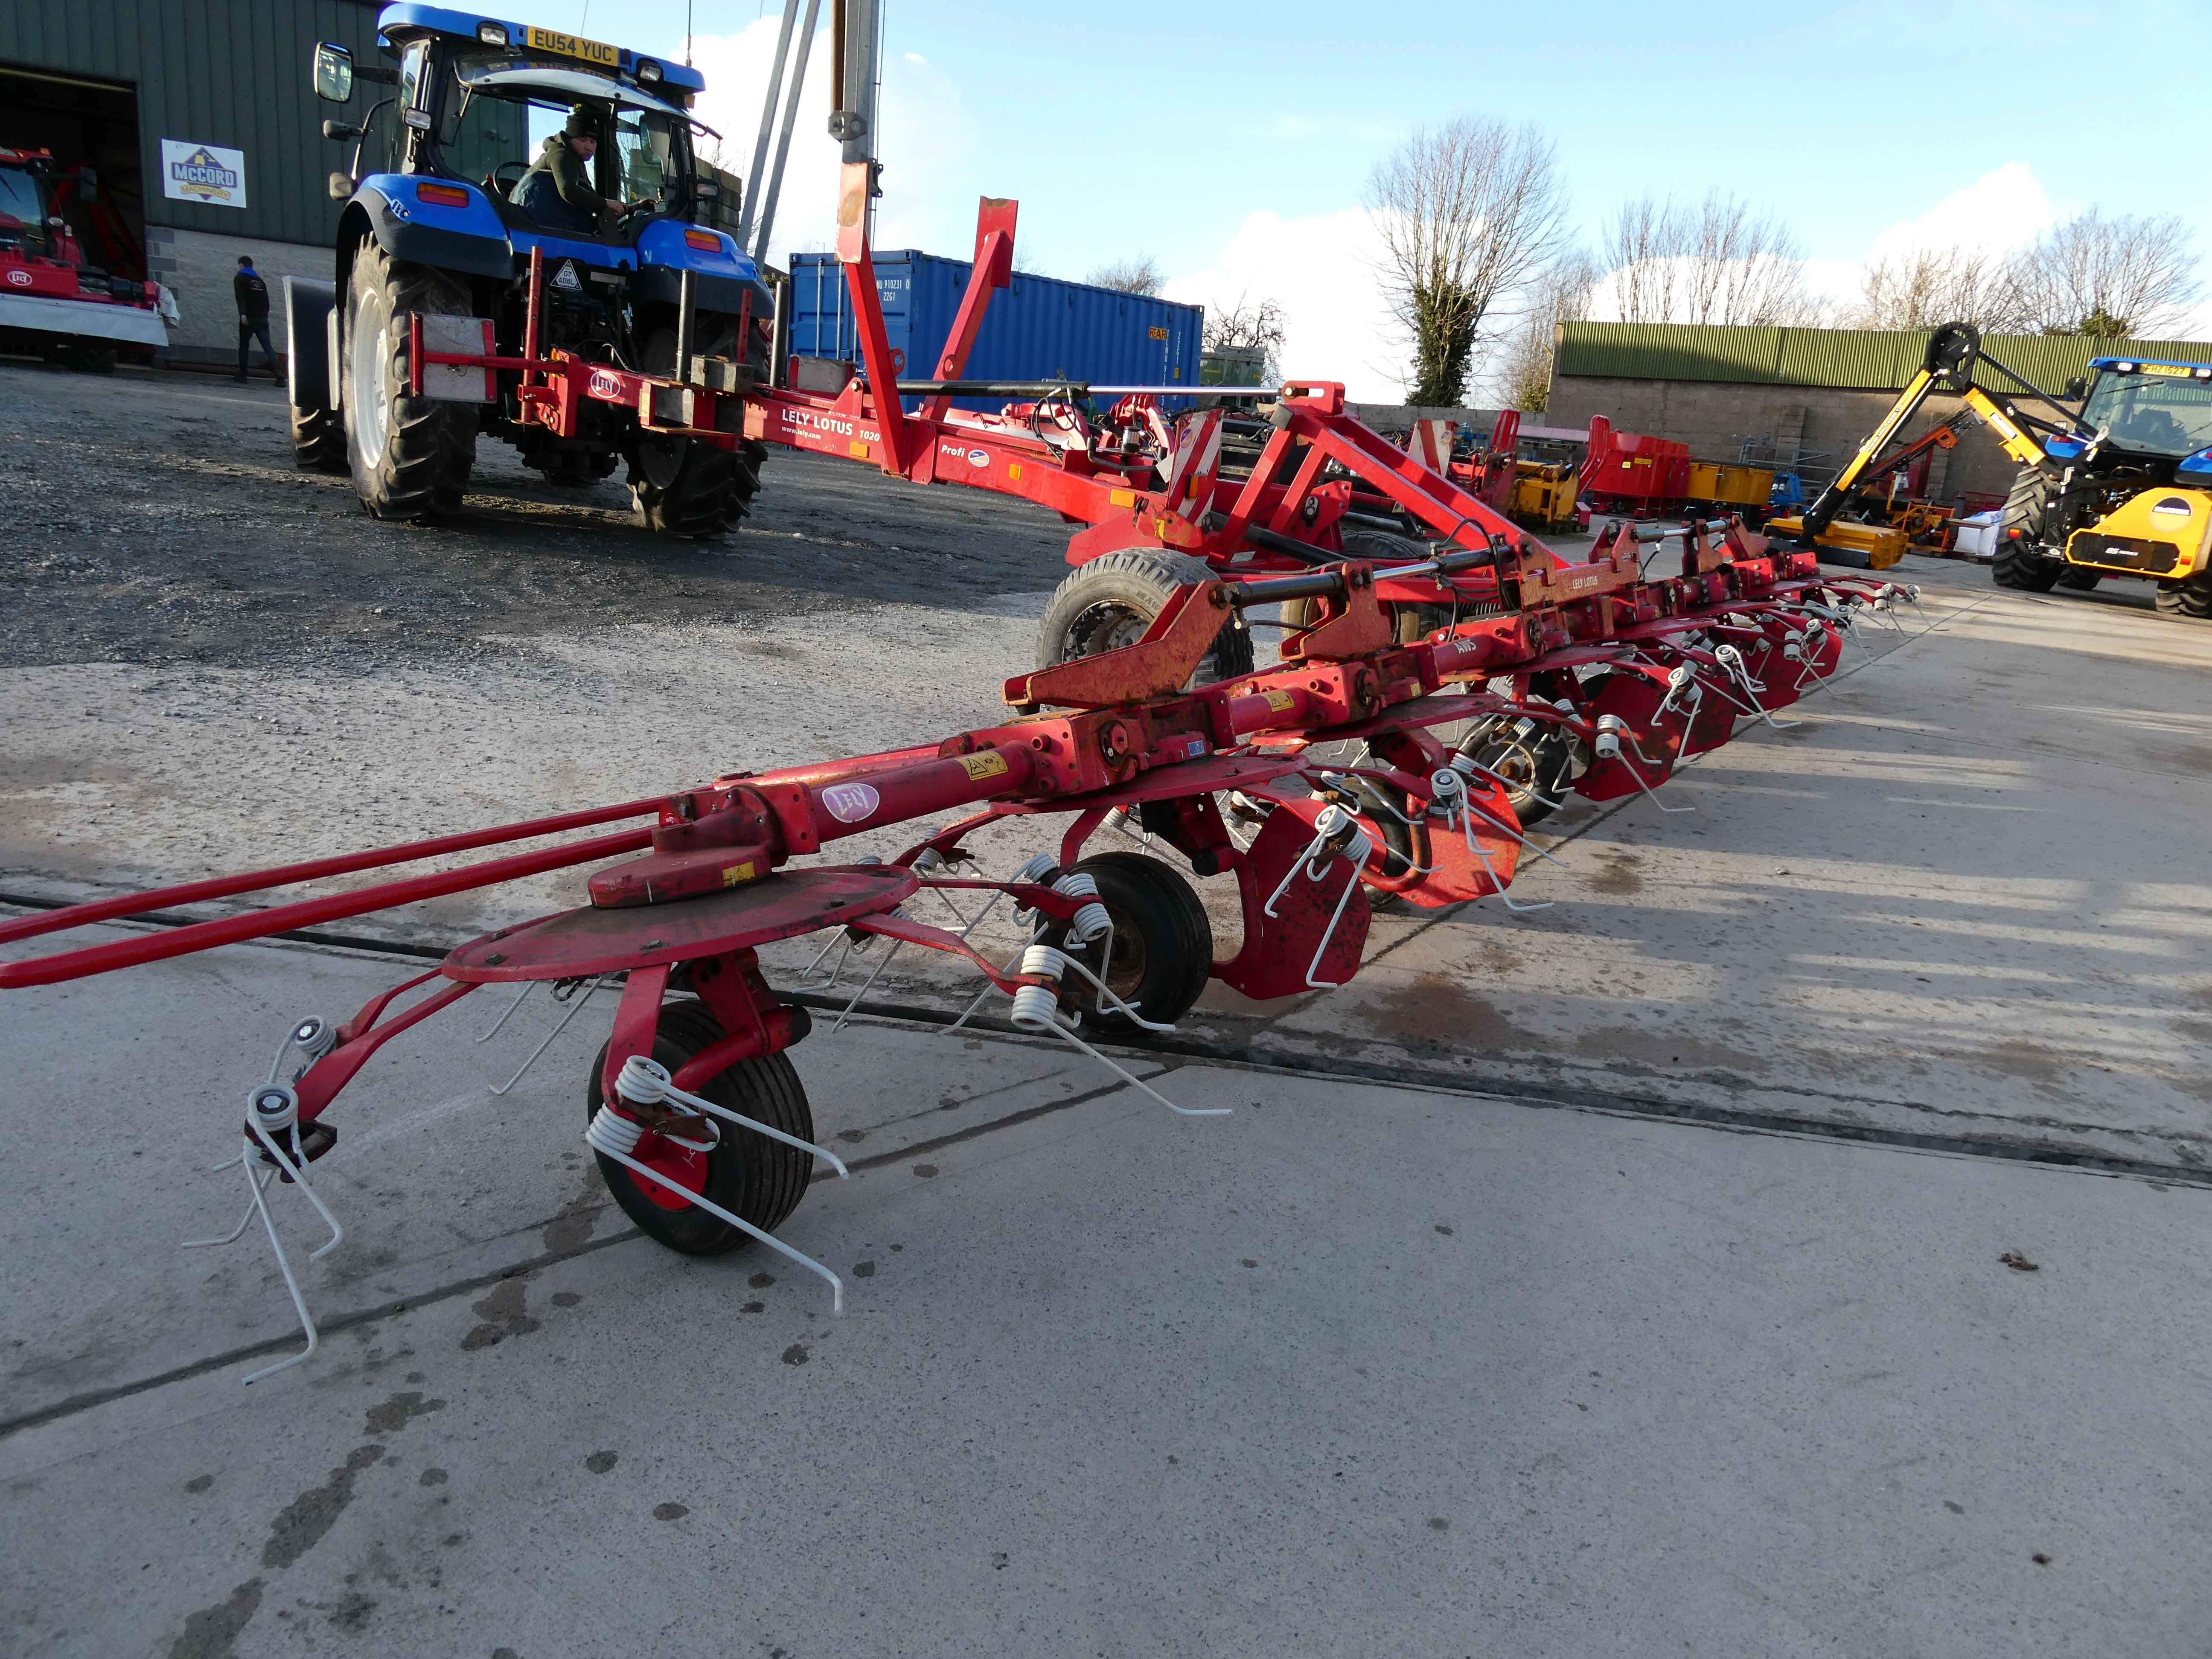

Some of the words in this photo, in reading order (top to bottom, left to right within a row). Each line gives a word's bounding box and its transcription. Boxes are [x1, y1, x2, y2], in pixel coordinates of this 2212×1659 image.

[535, 29, 576, 53] EU54
[582, 41, 611, 61] YUC
[181, 186, 228, 198] MACHINERY
[884, 279, 902, 289] 910231
[883, 291, 895, 301] 22G1
[1150, 327, 1166, 339] REAR
[2145, 365, 2163, 373] FHZ
[2164, 366, 2185, 375] 1527
[596, 375, 614, 394] LELY
[782, 409, 810, 425] LELY
[813, 416, 853, 436] LOTUS
[859, 430, 880, 442] 1020
[781, 426, 821, 440] www.lely.com
[941, 444, 965, 457] Profi
[1572, 578, 1583, 589] LELY
[1584, 575, 1598, 587] LOTUS
[828, 786, 869, 816] LELY
